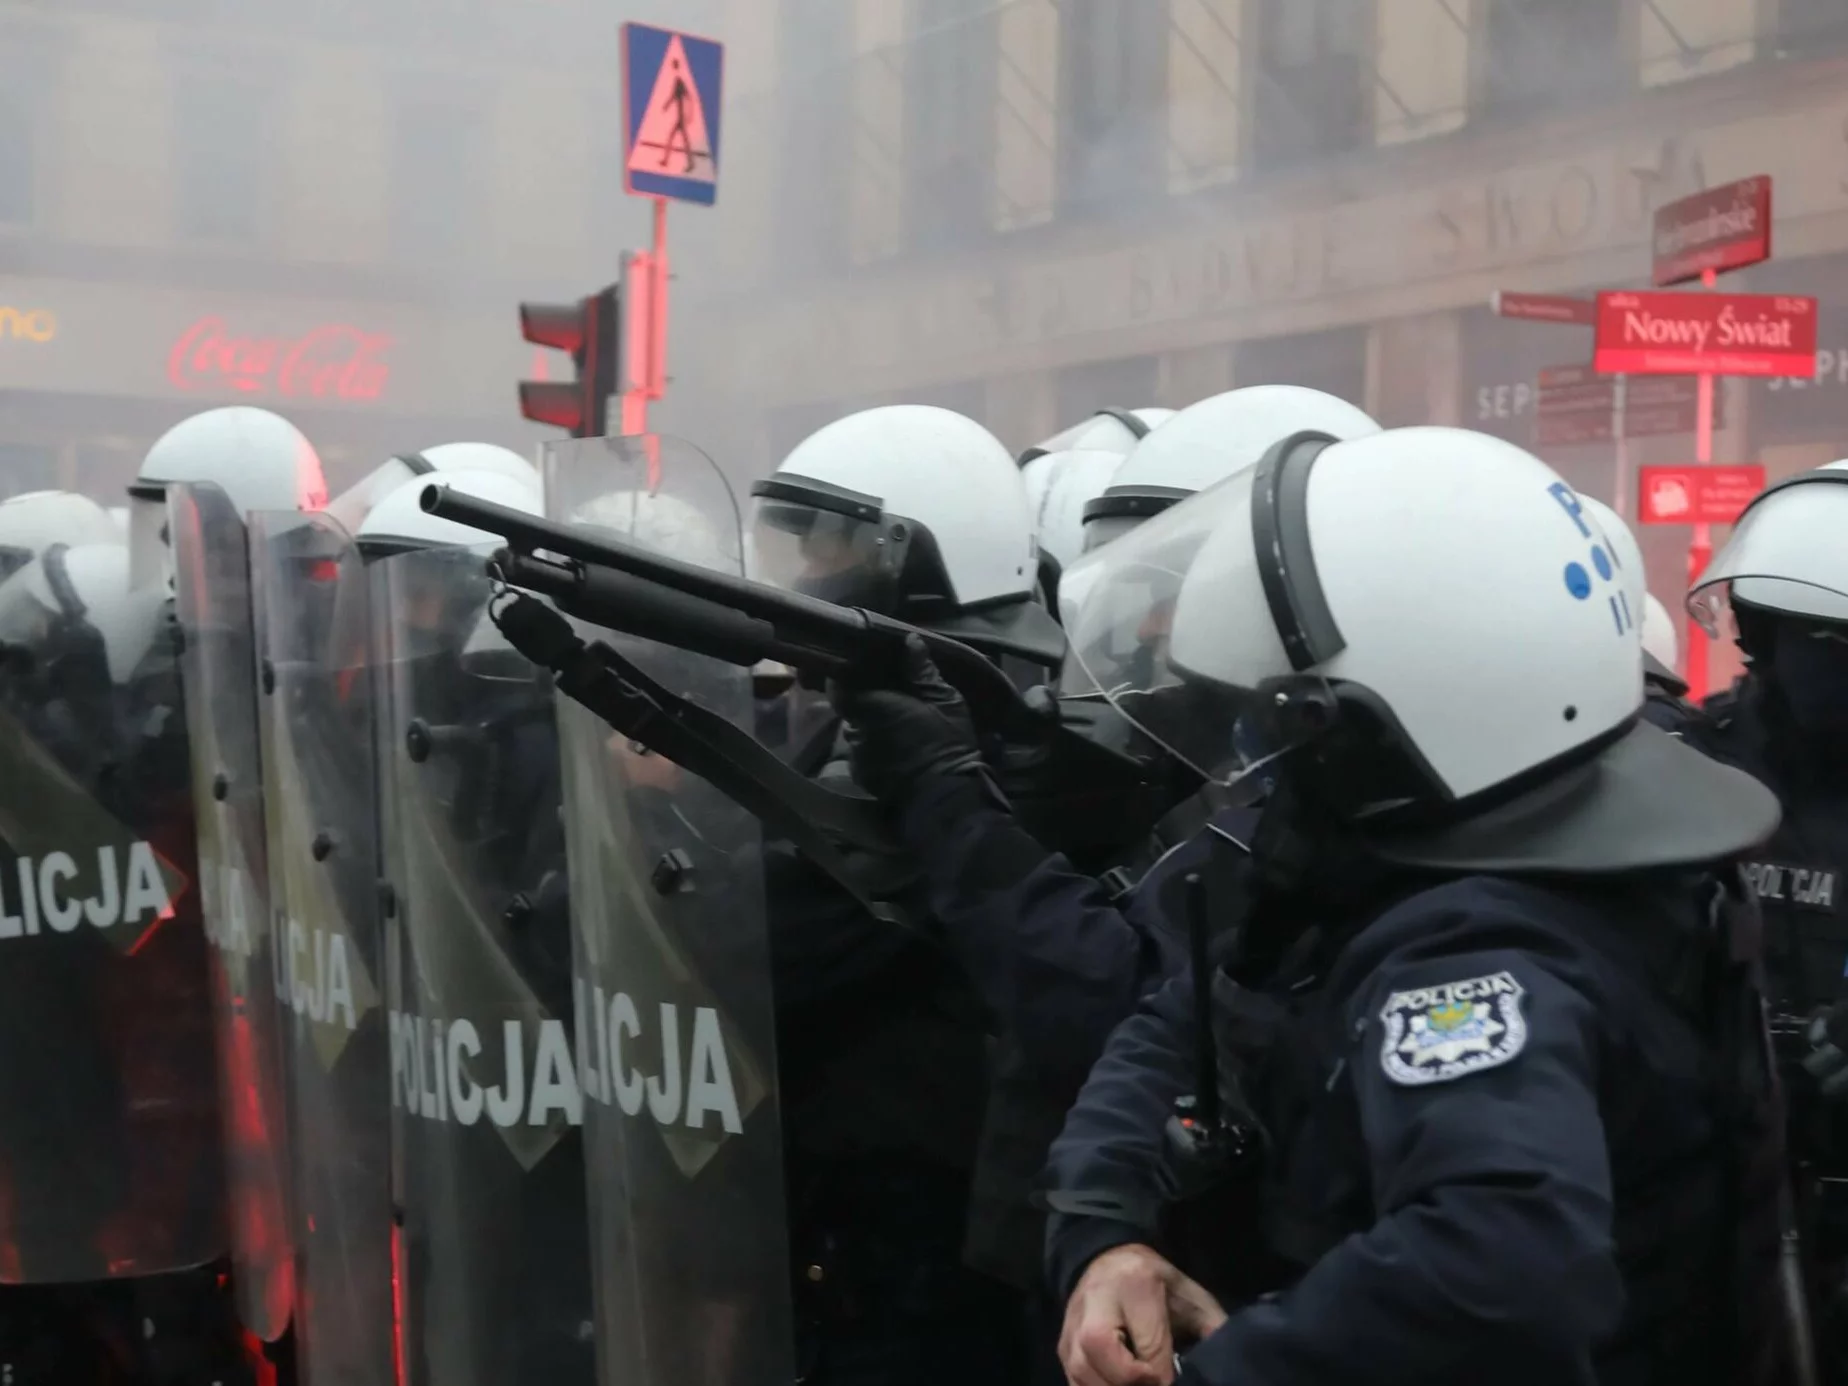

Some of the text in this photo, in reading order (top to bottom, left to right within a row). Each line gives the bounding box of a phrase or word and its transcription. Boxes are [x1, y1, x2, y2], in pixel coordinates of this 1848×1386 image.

[1624, 311, 1712, 354] Nowy
[1717, 304, 1791, 347] Świat
[1391, 972, 1514, 1010] POLICJA
[389, 1009, 585, 1128] POLICJA
